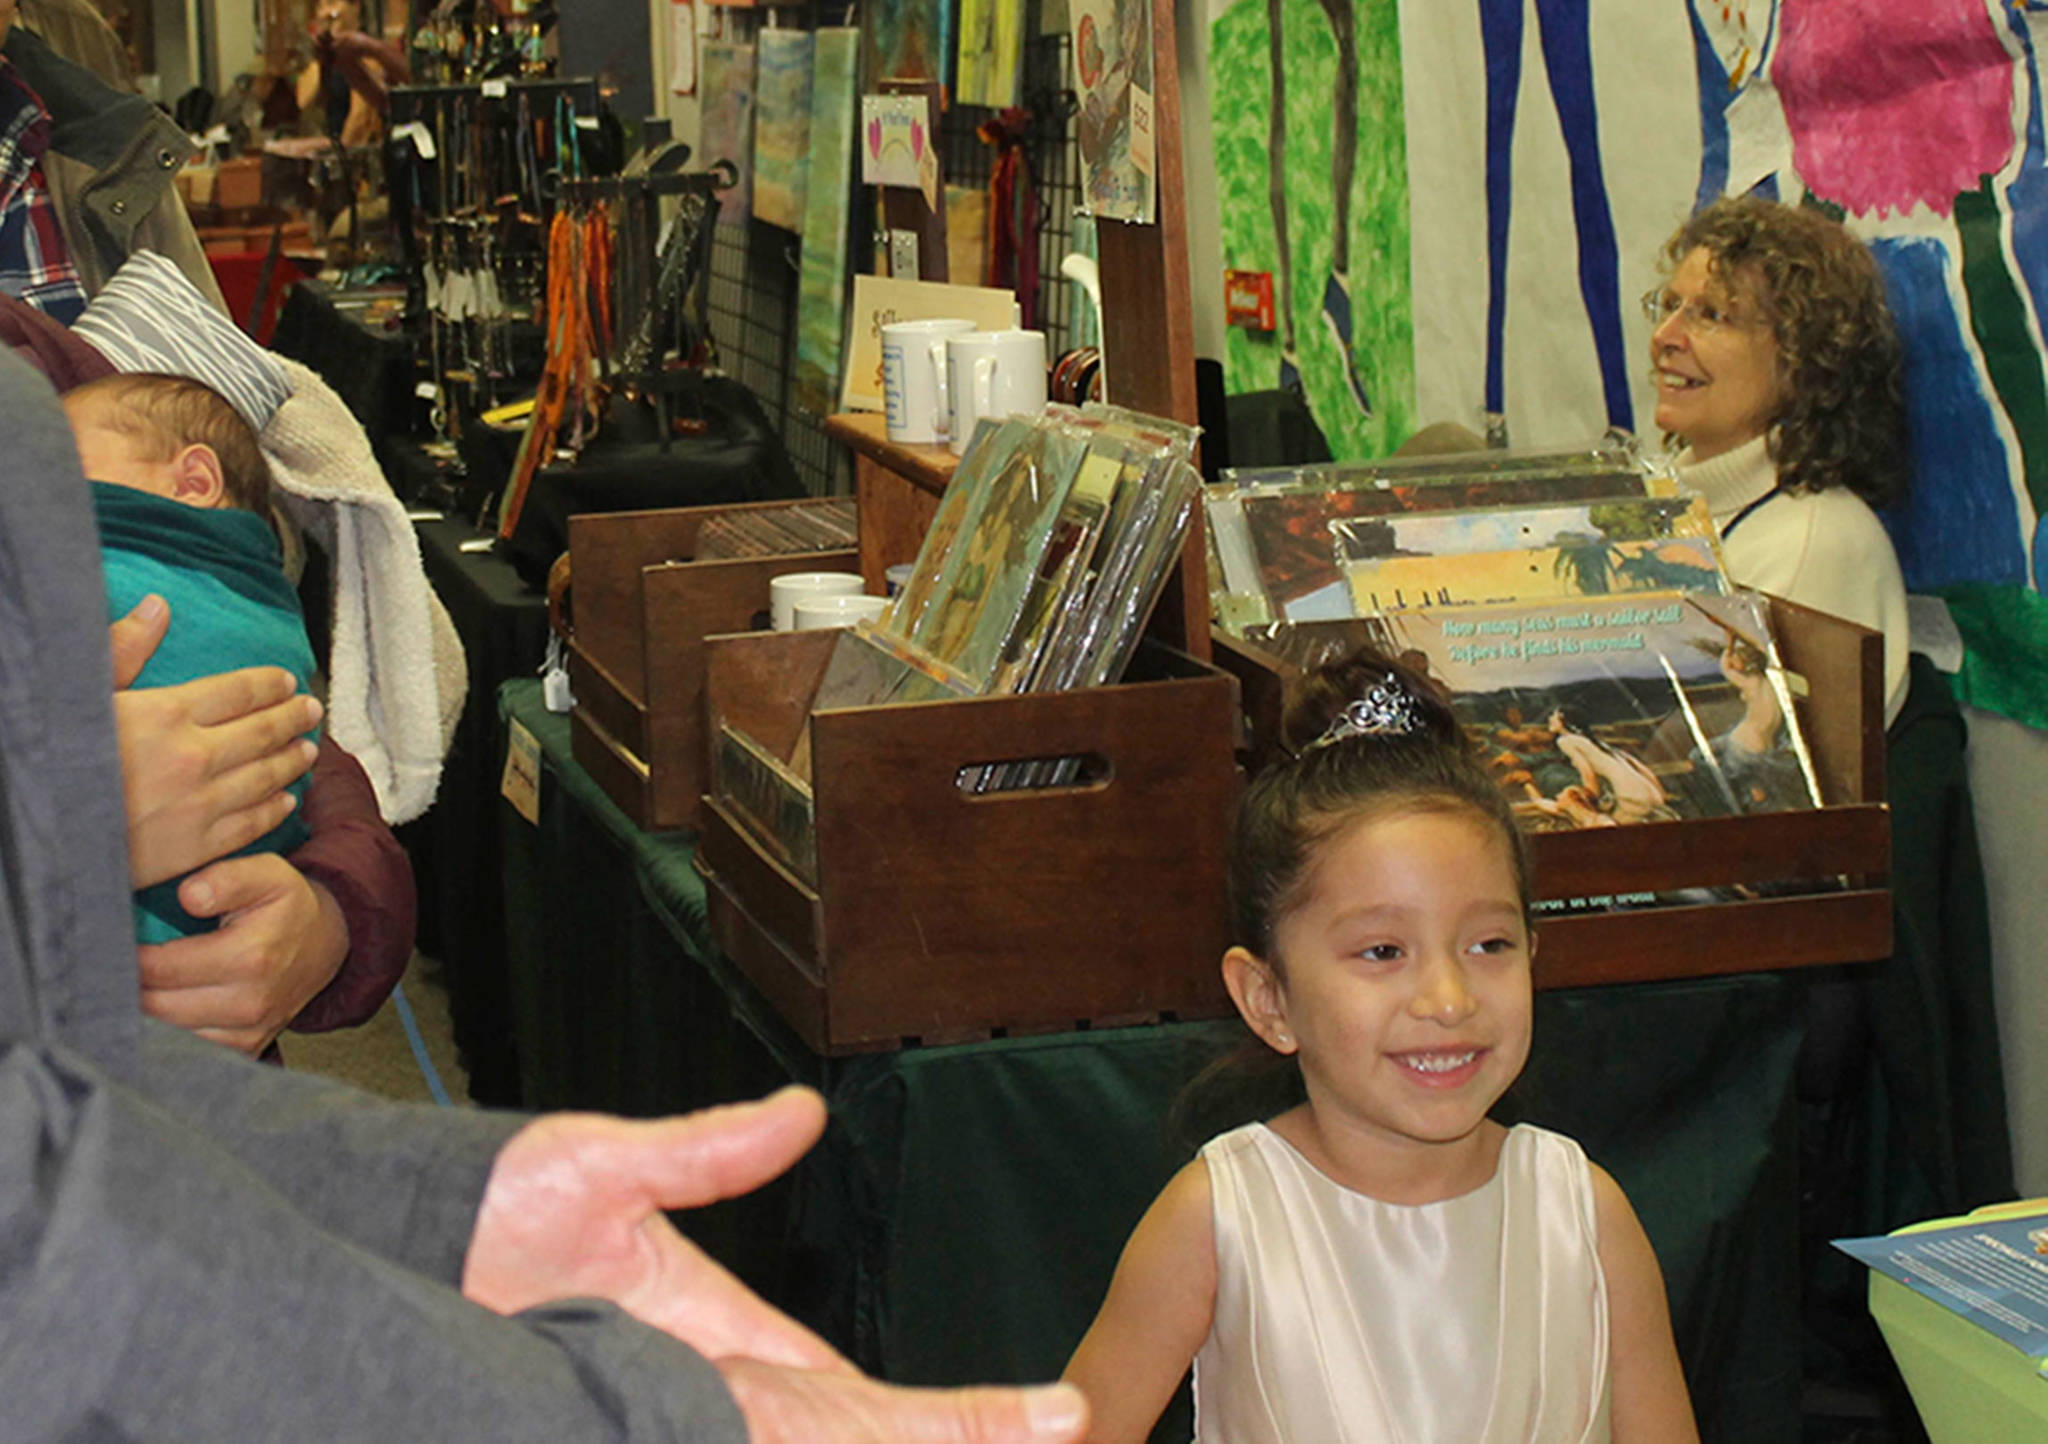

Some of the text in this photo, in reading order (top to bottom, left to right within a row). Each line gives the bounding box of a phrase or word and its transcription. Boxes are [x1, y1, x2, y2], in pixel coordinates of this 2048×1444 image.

[1443, 619, 1477, 637] How
[1479, 621, 1521, 640] many
[1501, 641, 1519, 658] he
[1558, 637, 1580, 655] his
[1580, 633, 1645, 654] mermaid
